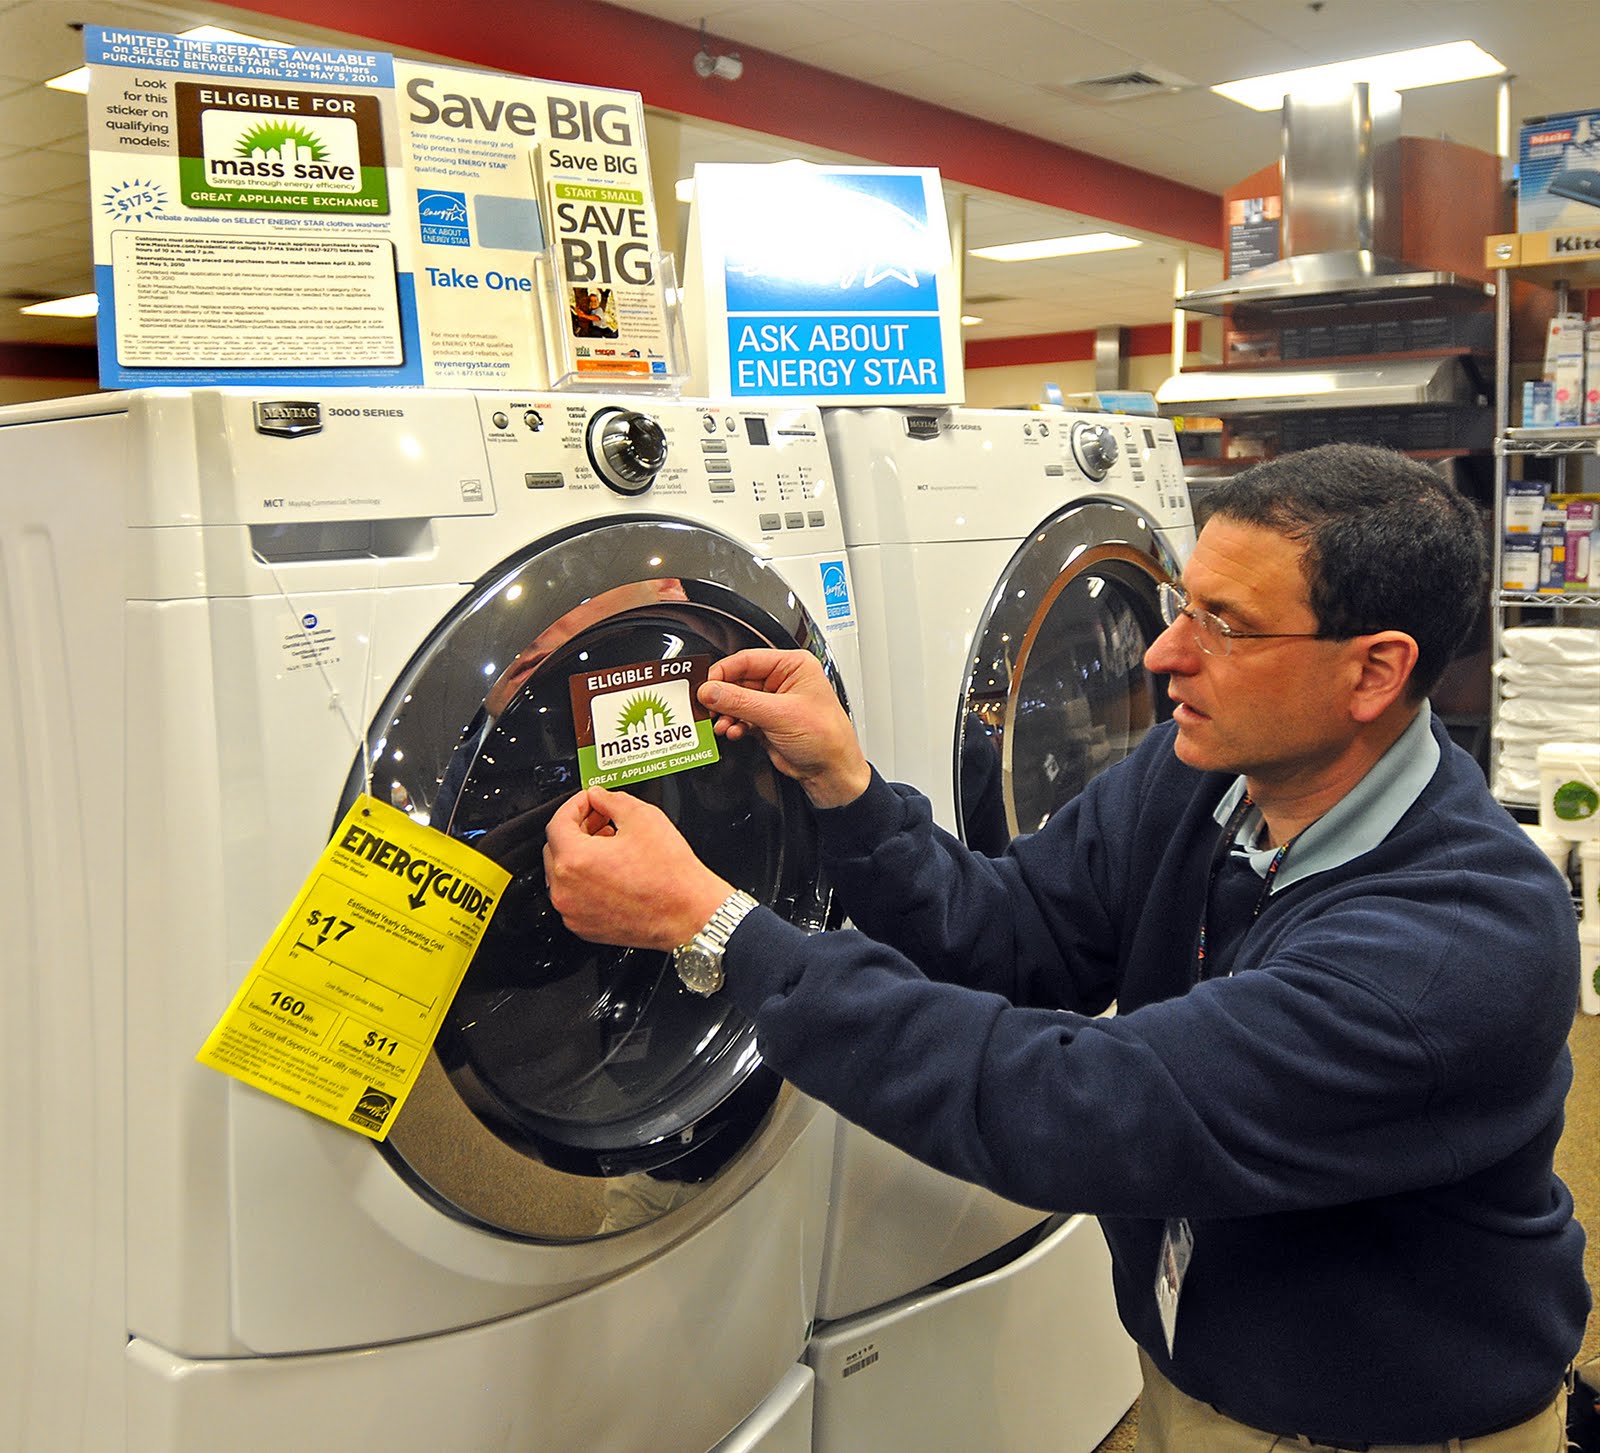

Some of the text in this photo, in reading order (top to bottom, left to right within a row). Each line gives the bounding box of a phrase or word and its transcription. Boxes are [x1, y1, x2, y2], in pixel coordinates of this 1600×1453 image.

[102, 32, 377, 66] LIMITED TIME REBATES AVAILABLE
[102, 53, 379, 84] PURCHASED BETWEEN APRIL 22 MAY 5, 2010
[112, 45, 370, 75] on SELECT ENERGY STAR clothes washers
[135, 78, 167, 90] Look
[124, 91, 168, 104] for this
[200, 90, 357, 114] ELIGIBLE FOR
[106, 105, 168, 118] sticker on
[406, 77, 632, 147] Save BIG
[106, 119, 169, 134] qualifying
[119, 135, 170, 148] models:
[412, 142, 517, 160] help protect the environment
[501, 141, 514, 149] and
[211, 158, 355, 180] mass save
[413, 154, 422, 163] by
[424, 155, 457, 166] choosing
[458, 158, 487, 168] ENERGY
[414, 165, 448, 176] qualified
[549, 150, 638, 174] Save BIG
[212, 177, 356, 191] Savings through energy efficiency
[563, 187, 638, 202] START SMALL
[117, 190, 153, 211] $175
[190, 191, 379, 208] GREAT APPLIANCE EXCHANGE
[155, 214, 182, 222] rebate
[268, 218, 302, 226] ENERGY
[557, 203, 646, 238] SAVE
[422, 226, 462, 236] ASK ABOUT
[423, 234, 450, 243] ENERGY
[561, 238, 655, 286] BIG
[425, 267, 532, 291] Take One
[737, 324, 909, 352] ASK ABOUT
[434, 361, 511, 369] myenergystar.com
[738, 358, 938, 388] ENERGY STAR
[263, 407, 404, 420] MAYTAG 3000 SERIES
[263, 499, 284, 508] MCT
[587, 661, 693, 691] ELIGIBLE FOR
[600, 724, 692, 758] mass save
[588, 749, 713, 787] GREAT APPLIANCE EXCHANGE
[601, 756, 627, 767] Savings
[627, 751, 650, 762] through
[339, 824, 494, 922] ENERGYGUIDE
[306, 909, 357, 942] $17
[346, 898, 380, 920] Estimated
[379, 915, 400, 931] Yearly
[400, 924, 430, 946] Operating
[429, 939, 445, 952] Cost
[270, 991, 315, 1024] 160 kWh
[363, 1031, 399, 1057] $11
